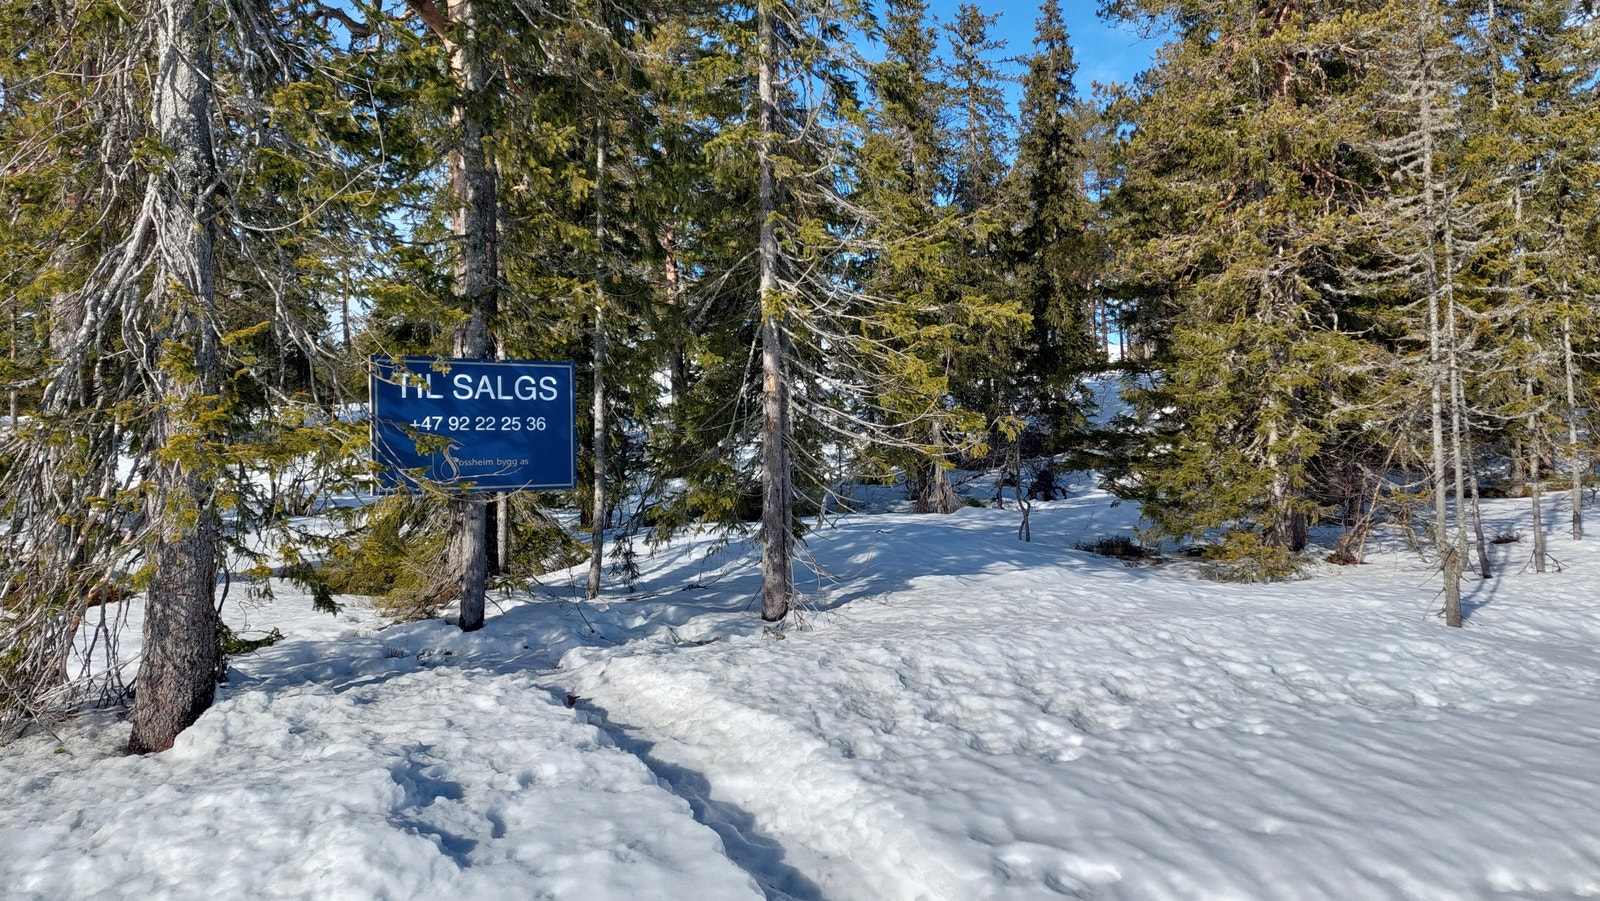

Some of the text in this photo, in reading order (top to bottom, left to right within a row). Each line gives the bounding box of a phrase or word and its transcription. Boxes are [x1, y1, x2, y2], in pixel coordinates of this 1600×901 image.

[397, 373, 558, 401] TIL SALGS
[410, 416, 546, 431] +47 92 22 25 36
[496, 458, 518, 467] bygg
[520, 458, 529, 466] as
